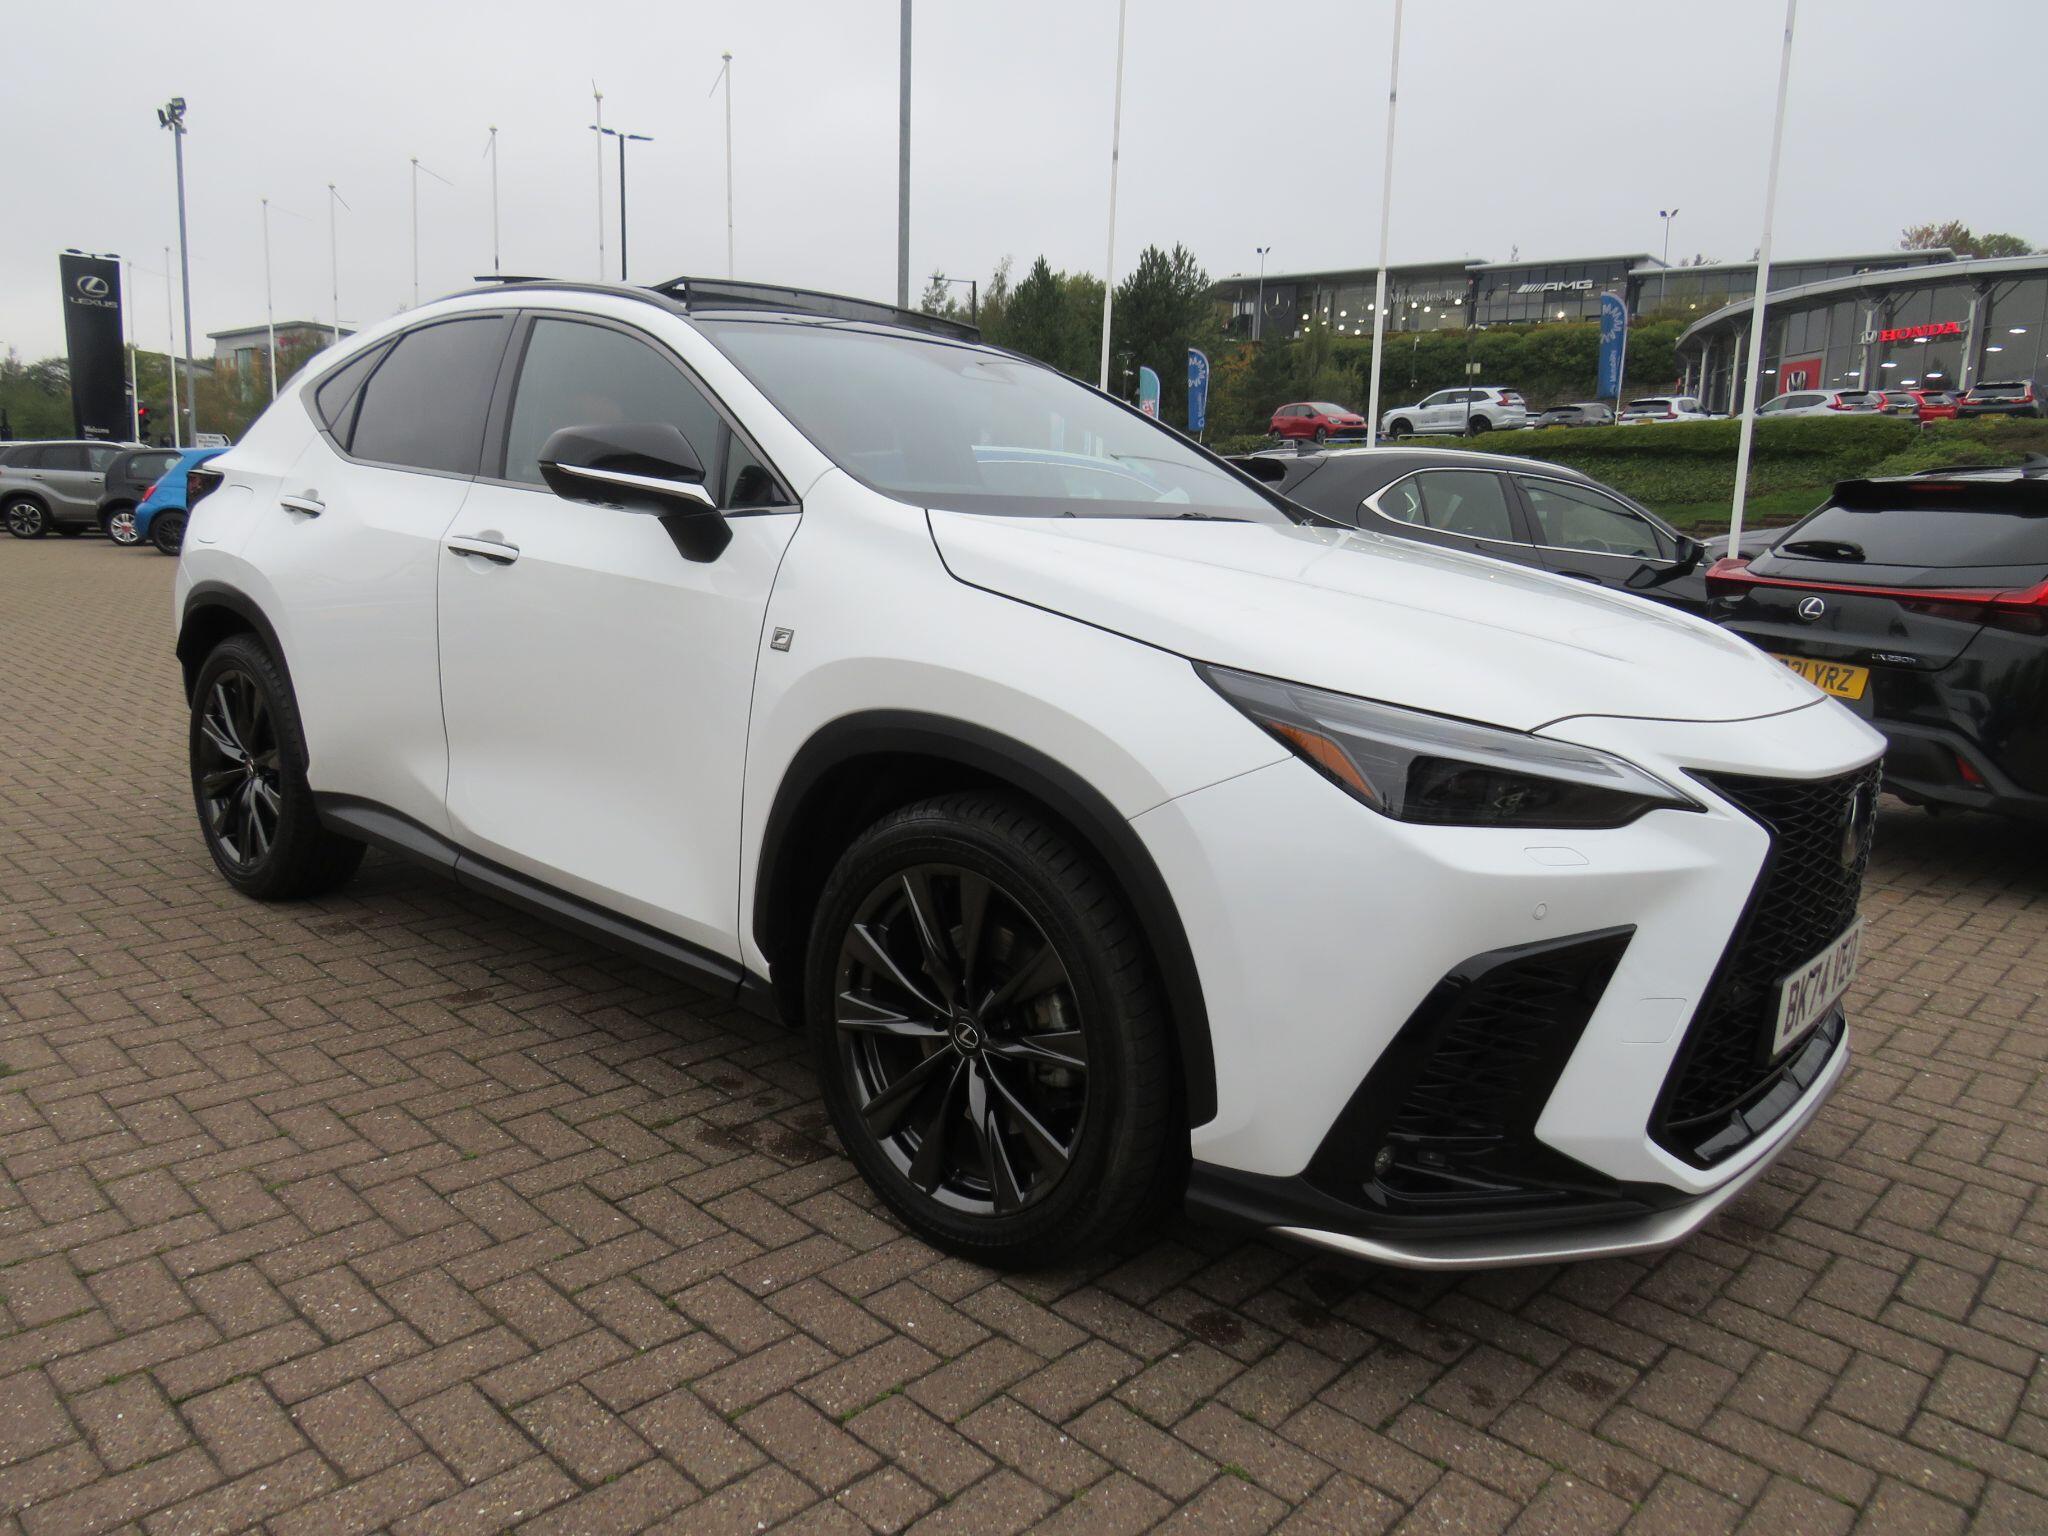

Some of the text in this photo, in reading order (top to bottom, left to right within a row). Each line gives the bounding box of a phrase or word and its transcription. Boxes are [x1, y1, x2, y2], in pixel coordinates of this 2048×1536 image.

[1540, 279, 1594, 291] AMG
[70, 297, 119, 309] LEXUS
[1879, 322, 1962, 342] HONDA
[1813, 663, 1855, 692] YRZ
[1783, 954, 1831, 1037] BK74
